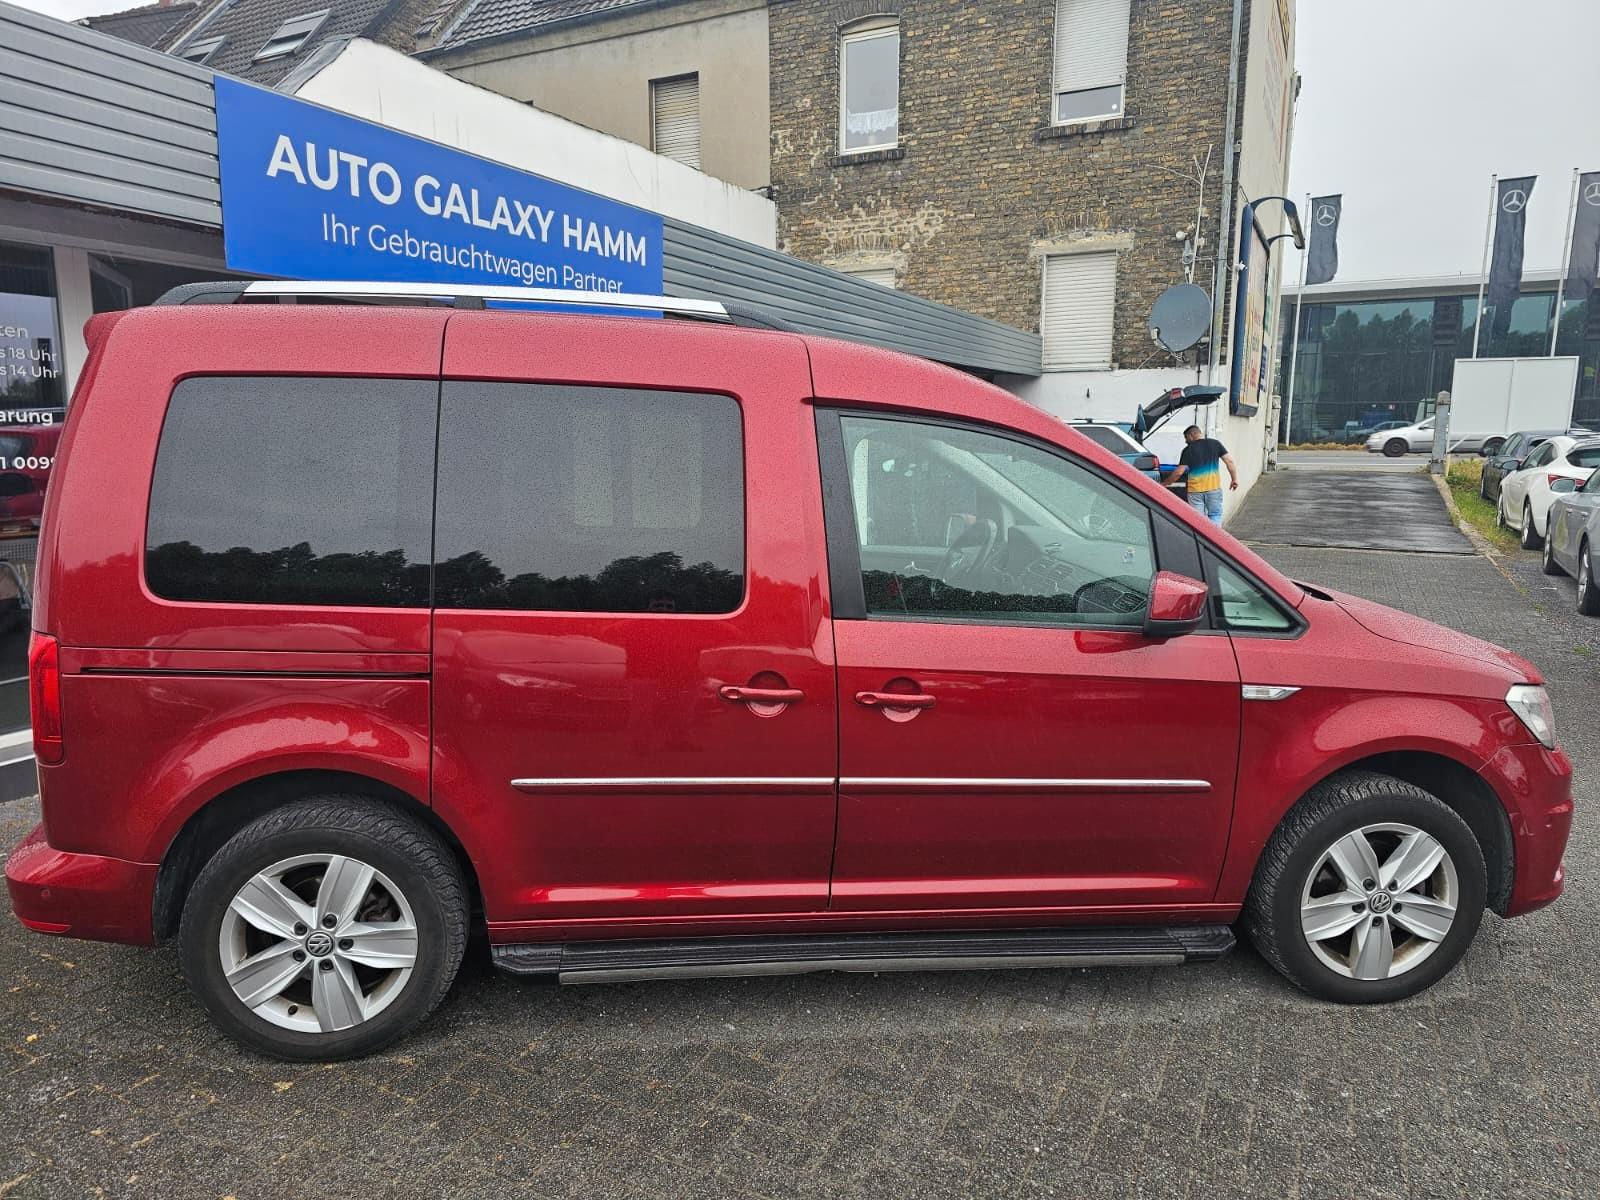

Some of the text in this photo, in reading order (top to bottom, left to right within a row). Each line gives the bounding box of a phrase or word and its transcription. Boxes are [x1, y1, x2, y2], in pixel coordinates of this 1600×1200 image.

[266, 134, 647, 266] AUTO GALAXY HAMM
[323, 213, 624, 294] Ihr Gebrauchtwagen Partner
[9, 346, 26, 360] 18
[30, 349, 57, 362] Uhr
[10, 364, 27, 377] 14
[31, 365, 58, 379] Uhr
